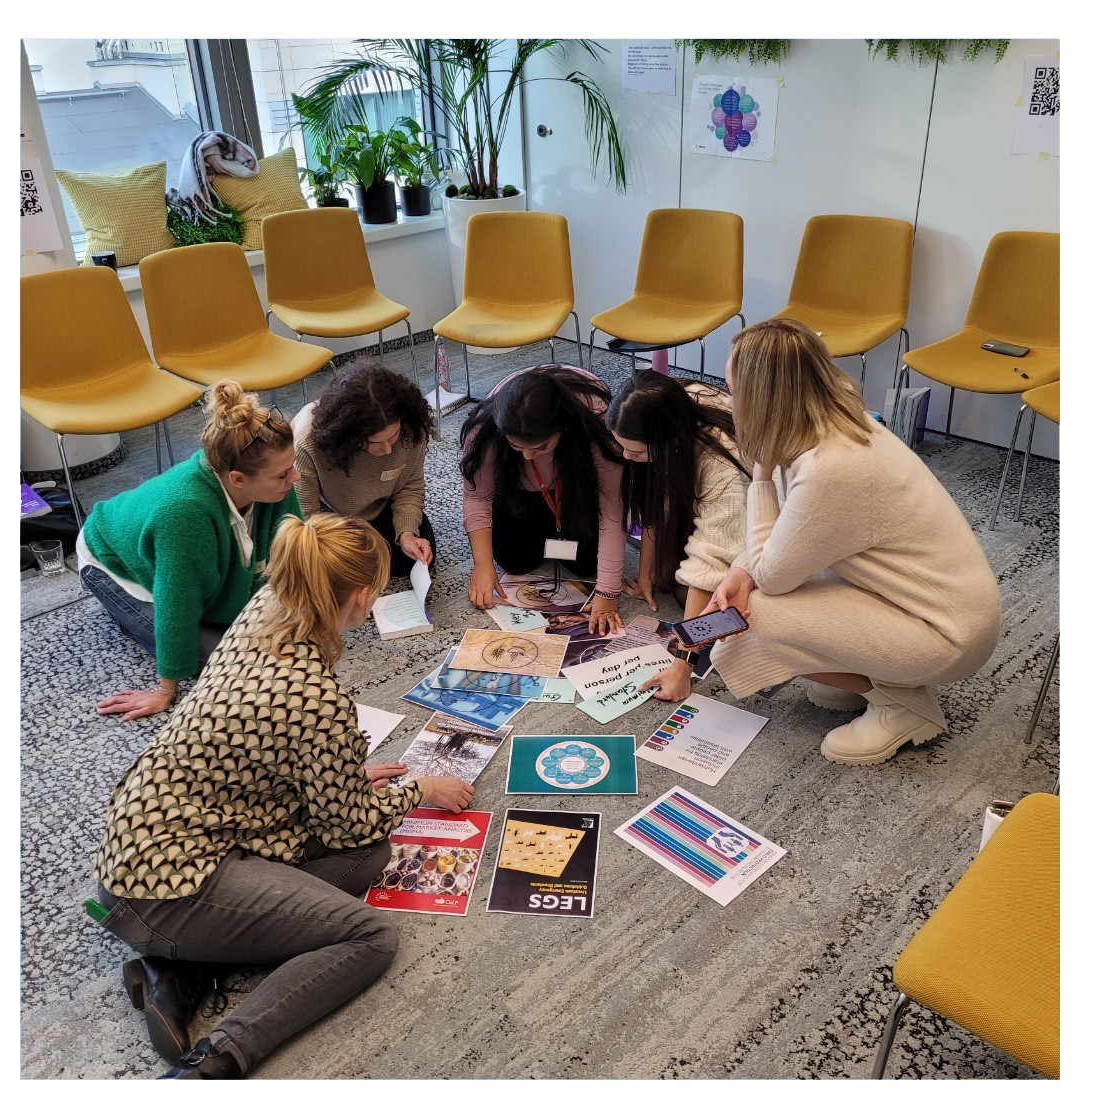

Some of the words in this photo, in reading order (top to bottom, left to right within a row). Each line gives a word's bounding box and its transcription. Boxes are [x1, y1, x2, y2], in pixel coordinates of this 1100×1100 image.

[622, 656, 640, 666] per
[602, 662, 620, 674] day
[584, 674, 622, 688] person
[529, 895, 587, 911] LEGS
